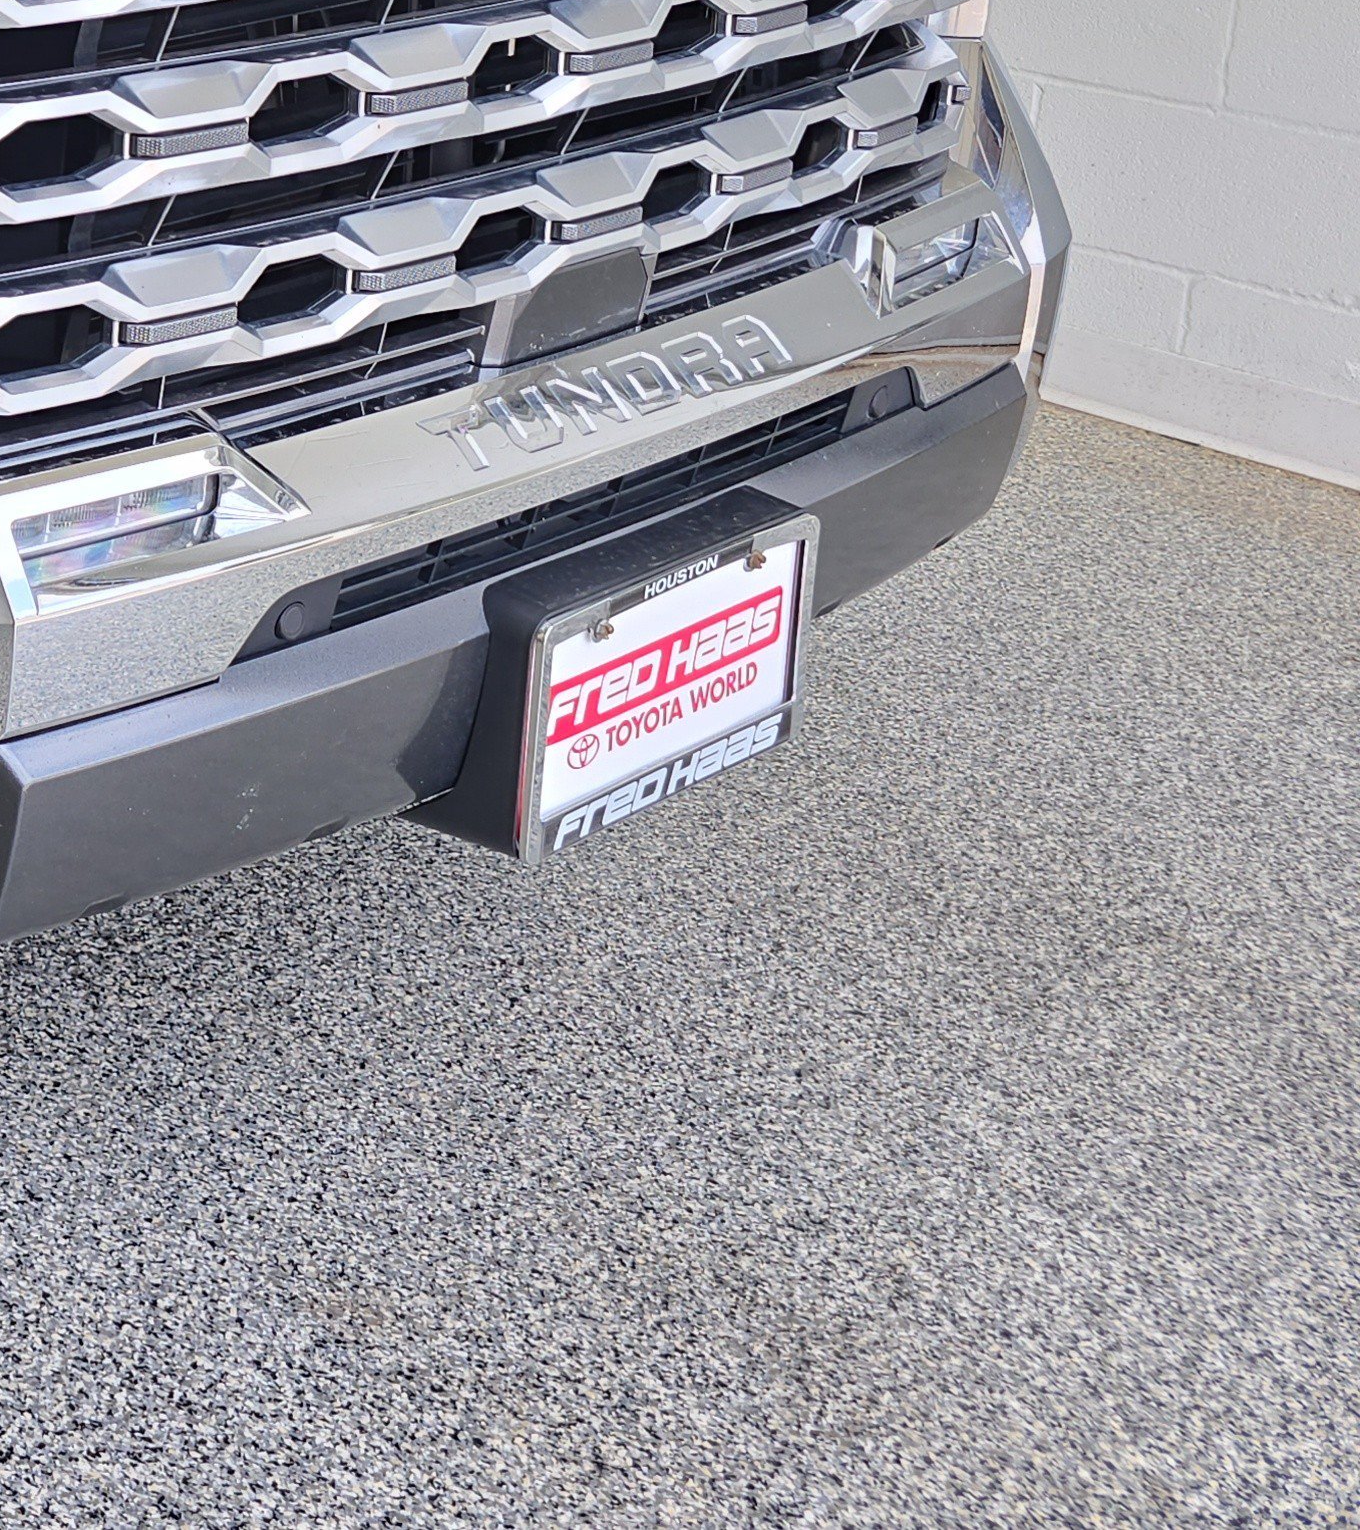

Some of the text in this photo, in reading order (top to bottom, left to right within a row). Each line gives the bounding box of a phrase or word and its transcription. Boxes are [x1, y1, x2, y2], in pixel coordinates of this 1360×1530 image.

[416, 314, 793, 471] TUNDRA
[644, 554, 718, 599] HOUSTON
[605, 661, 758, 752] TOYOTA WORLD
